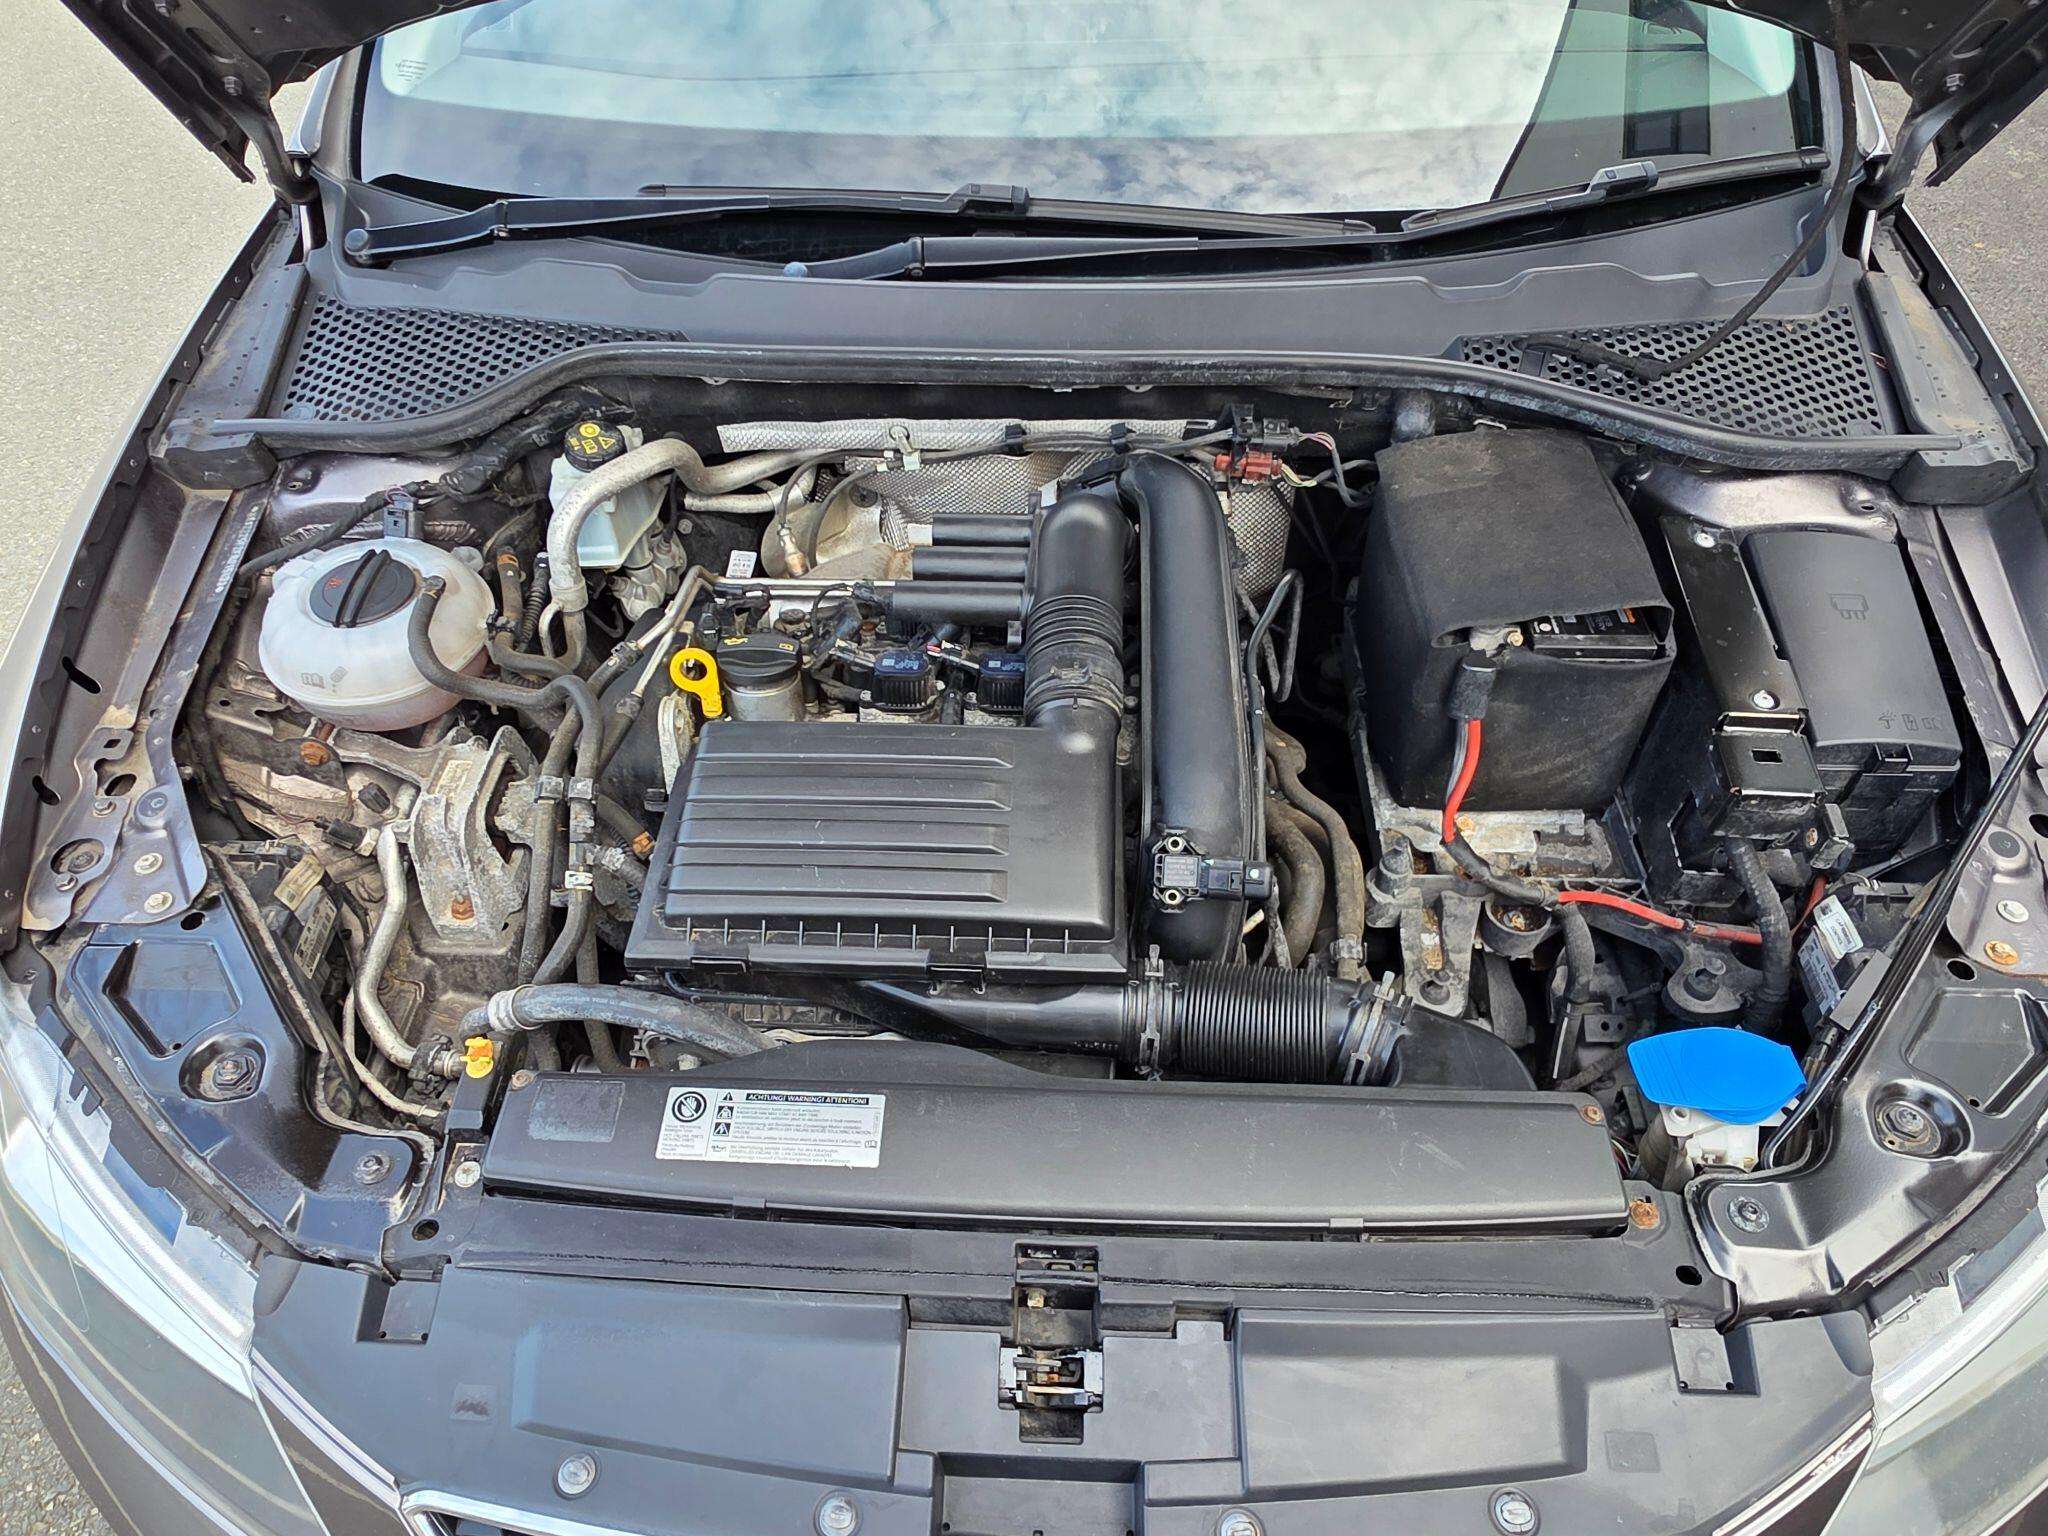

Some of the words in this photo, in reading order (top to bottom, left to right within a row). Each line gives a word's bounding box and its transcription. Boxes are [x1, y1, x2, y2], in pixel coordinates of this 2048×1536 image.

[748, 1093, 786, 1101] ACHTUNG!
[787, 1094, 824, 1103] WARNING!
[825, 1096, 867, 1104] ATTENTION!
